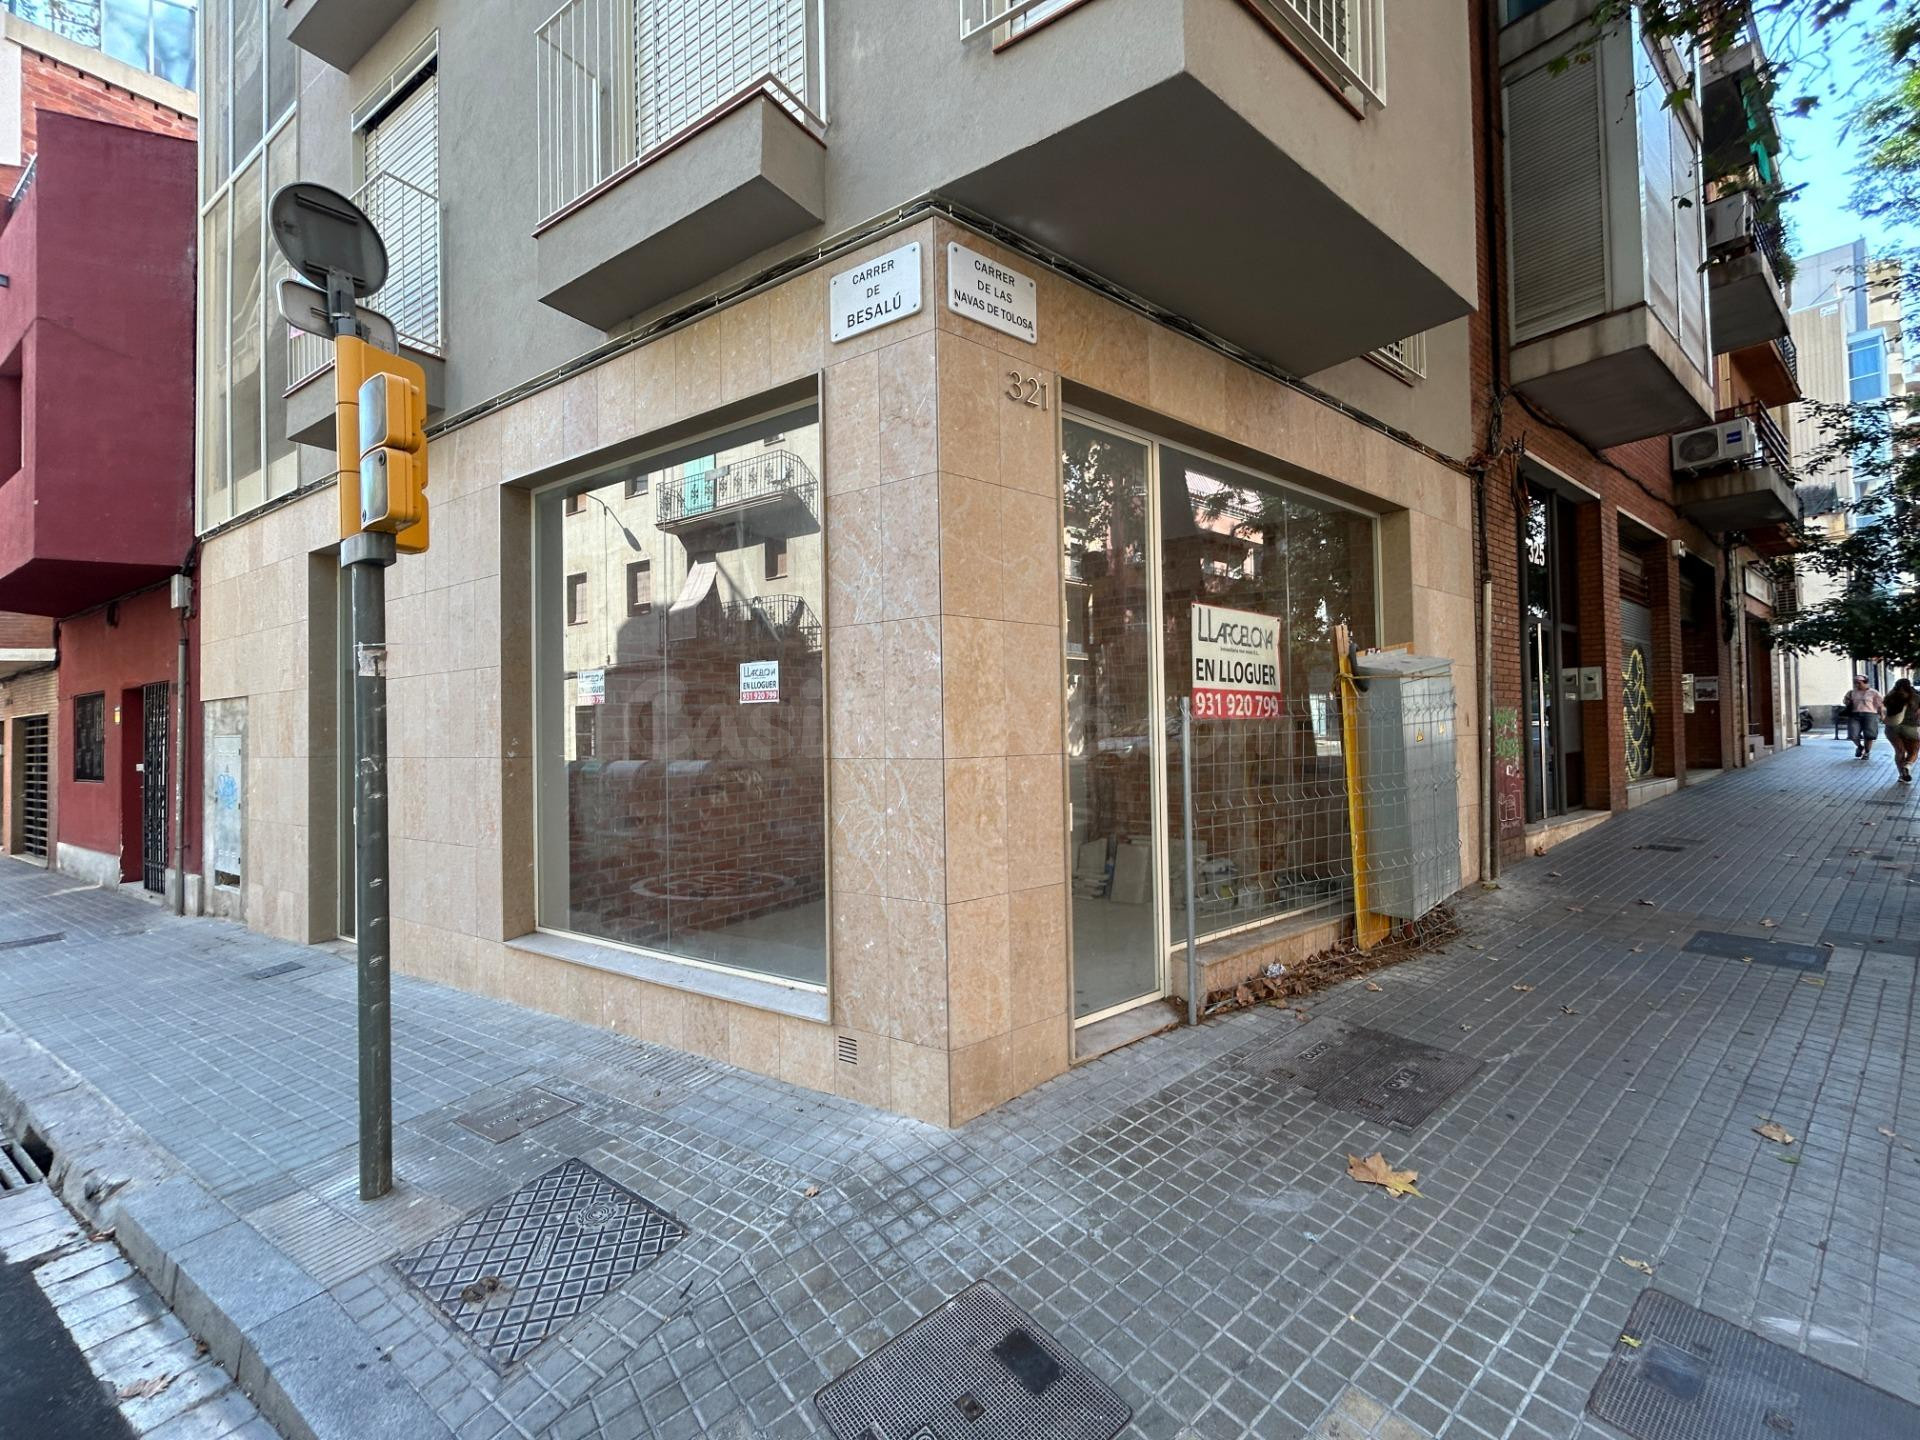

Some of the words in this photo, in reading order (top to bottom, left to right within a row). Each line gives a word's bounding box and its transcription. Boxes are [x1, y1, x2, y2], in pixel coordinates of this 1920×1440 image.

[852, 259, 895, 285] CARRER
[974, 260, 1015, 287] CARRER
[866, 284, 880, 299] DE
[977, 280, 991, 295] DE
[994, 287, 1012, 304] LAS
[847, 291, 902, 329] BESALÚ
[954, 288, 985, 311] NAVAS
[987, 303, 999, 317] DE
[1000, 308, 1034, 332] TOLOSA
[1006, 370, 1049, 411] 321
[1525, 537, 1545, 567] 325
[1198, 607, 1273, 651] LLARCELONA
[743, 682, 751, 690] EN
[751, 680, 777, 690] LLOGUER
[1195, 658, 1215, 681] EN
[1219, 660, 1276, 686] LLOGUER
[742, 692, 753, 701] 931
[753, 691, 766, 700] 920
[766, 690, 777, 699] 799
[1195, 692, 1222, 716] 931
[1226, 693, 1253, 717] 920
[1255, 695, 1279, 718] 799
